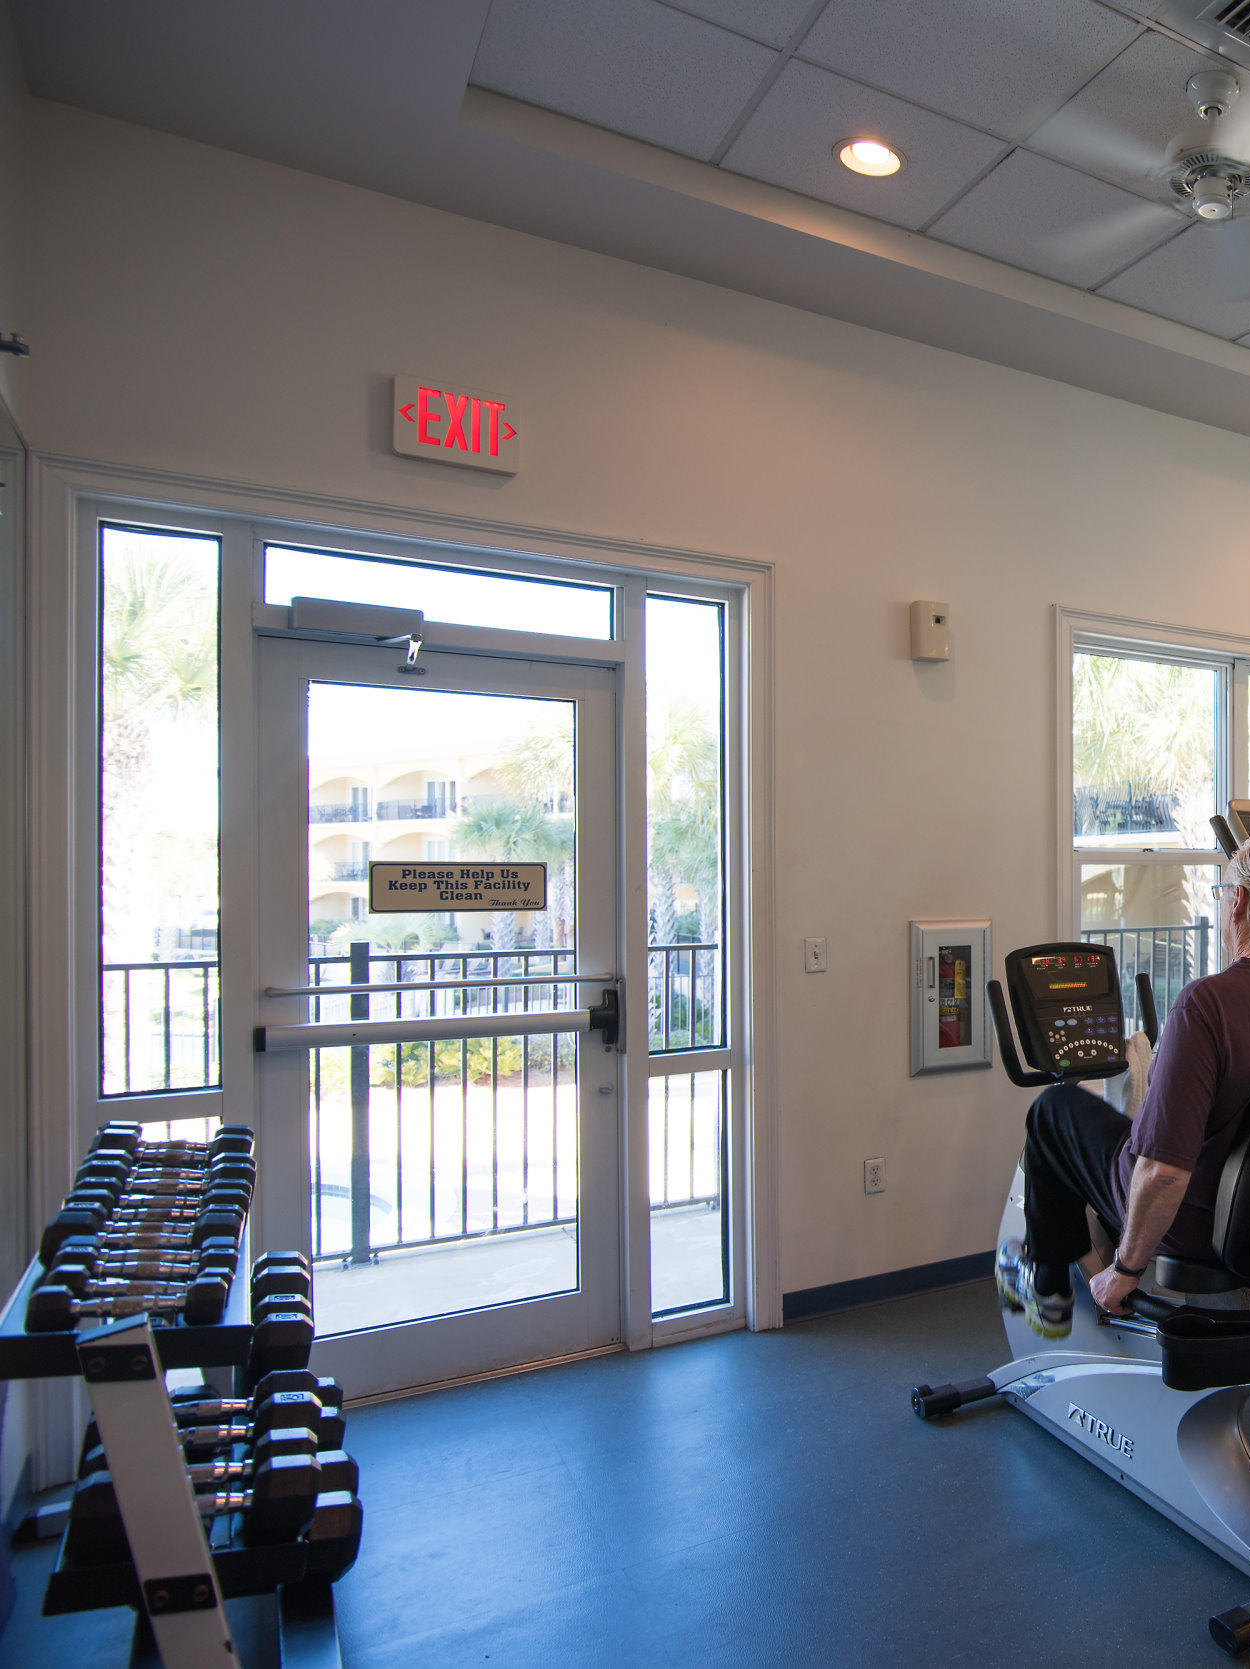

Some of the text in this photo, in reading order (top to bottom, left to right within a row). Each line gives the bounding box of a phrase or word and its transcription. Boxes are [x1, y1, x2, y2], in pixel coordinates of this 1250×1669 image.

[417, 387, 506, 457] EXIT
[401, 869, 519, 881] Please Help Us
[388, 880, 530, 892] Keep This Facility
[440, 890, 483, 900] Clean
[489, 899, 540, 907] Thank You
[1084, 1410, 1134, 1459] TRUE
